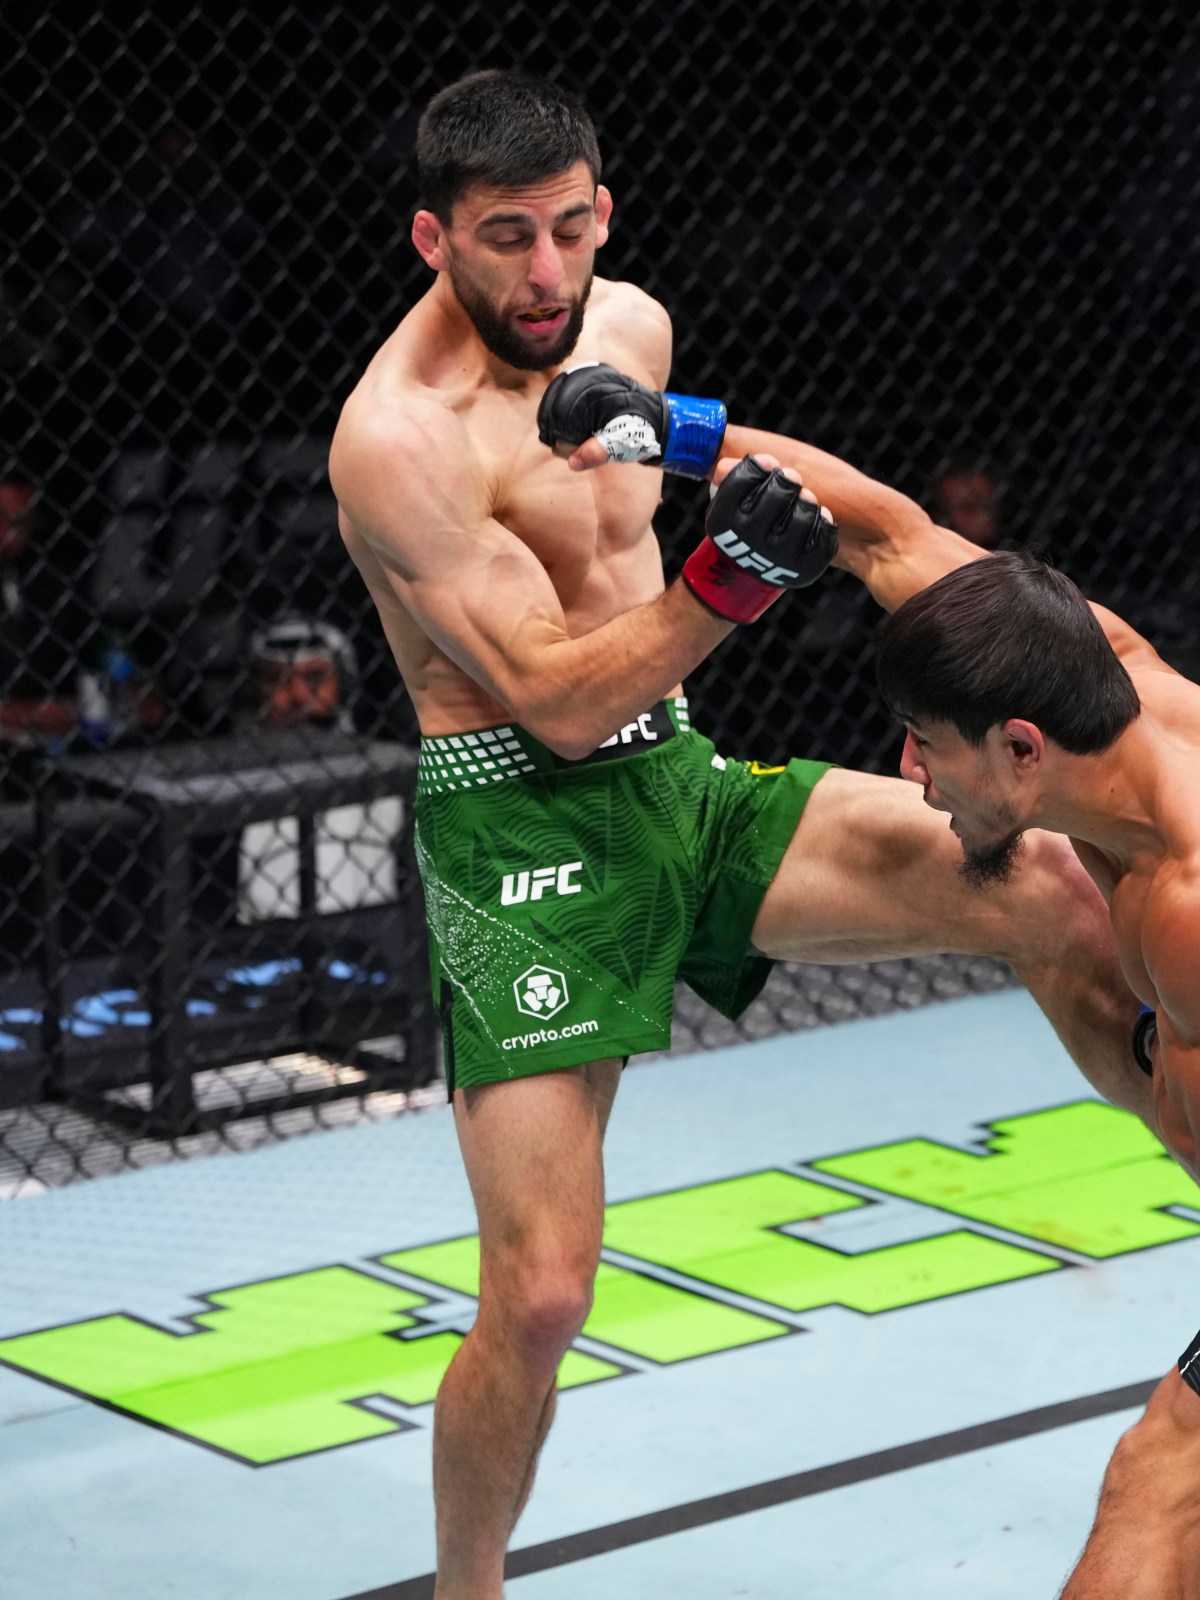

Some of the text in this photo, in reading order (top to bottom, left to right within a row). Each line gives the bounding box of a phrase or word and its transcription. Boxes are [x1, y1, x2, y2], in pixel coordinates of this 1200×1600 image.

[713, 529, 799, 586] UFC
[500, 861, 583, 906] UFC
[502, 1019, 599, 1051] crypto.com
